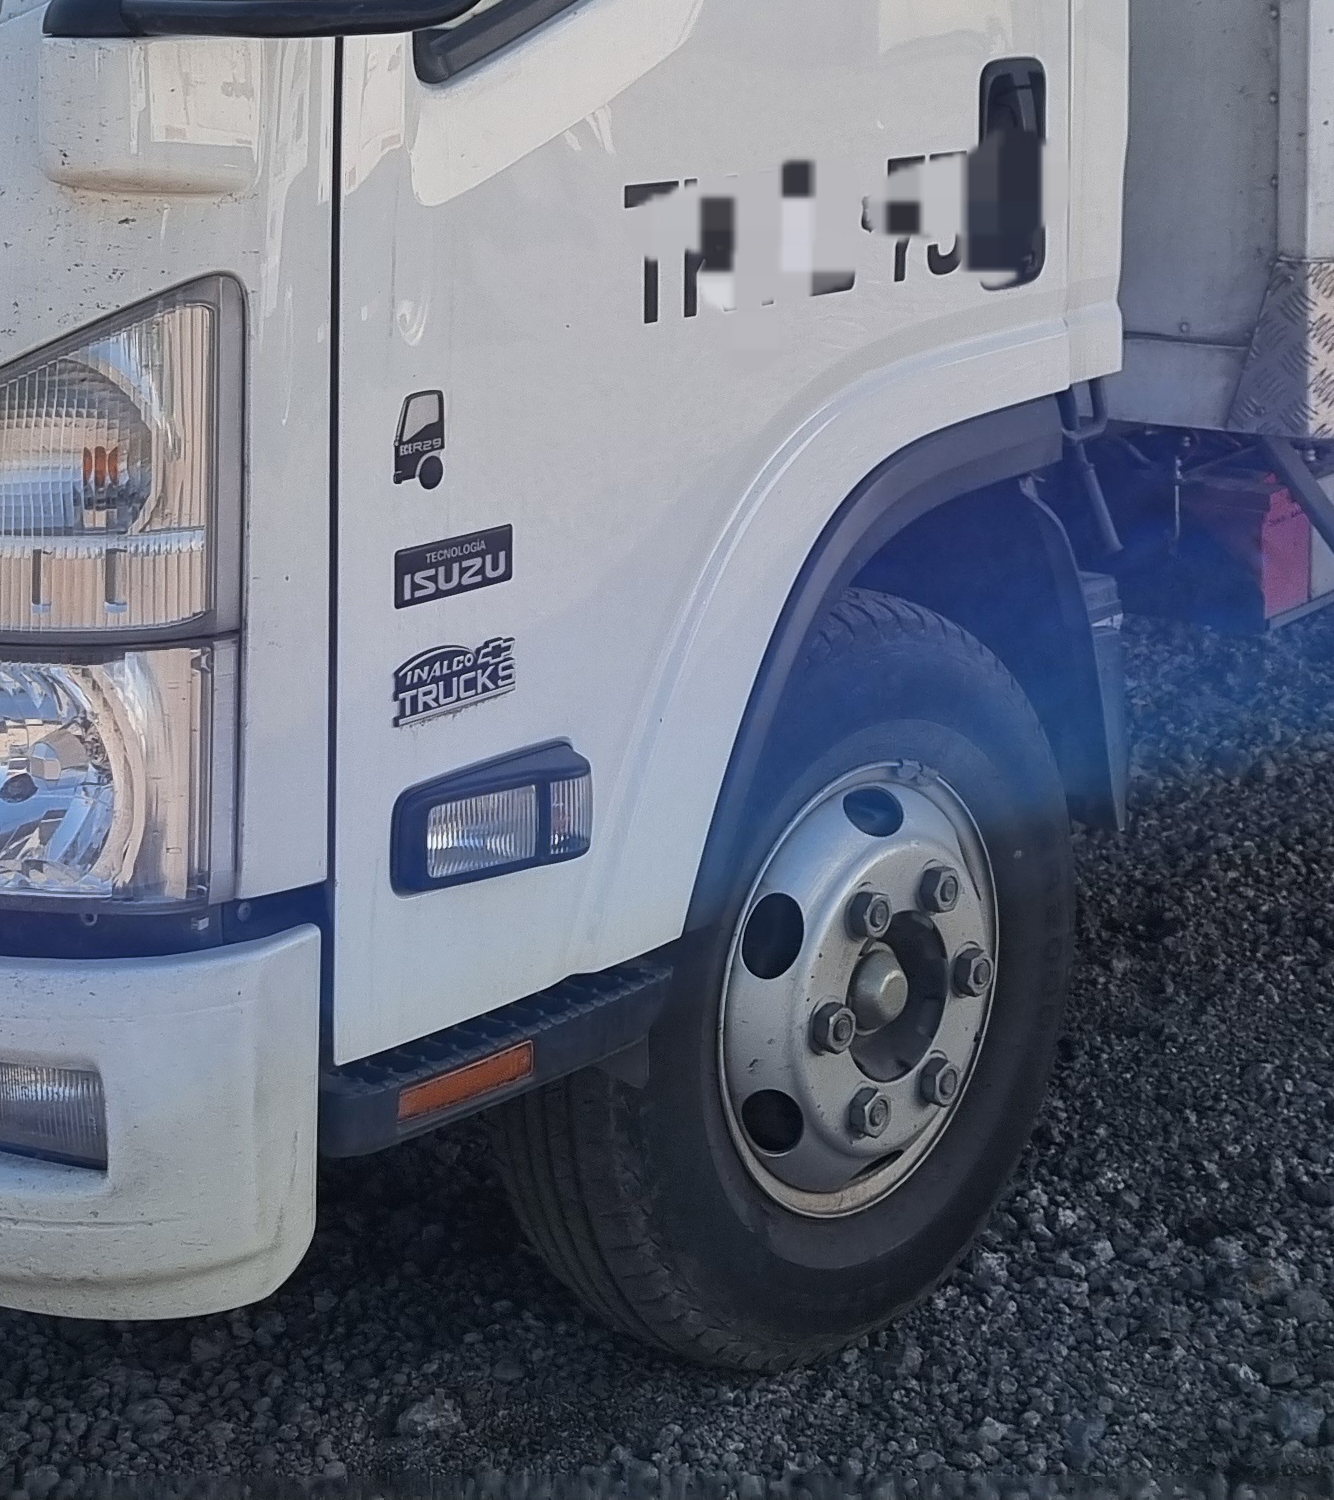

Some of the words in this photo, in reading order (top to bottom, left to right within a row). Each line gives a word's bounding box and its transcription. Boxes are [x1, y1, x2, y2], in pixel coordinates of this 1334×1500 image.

[425, 538, 486, 564] TECNOLOGÍA
[403, 550, 507, 601] ISUZU
[398, 659, 516, 717] TRUCKS
[405, 652, 475, 685] INALCO
